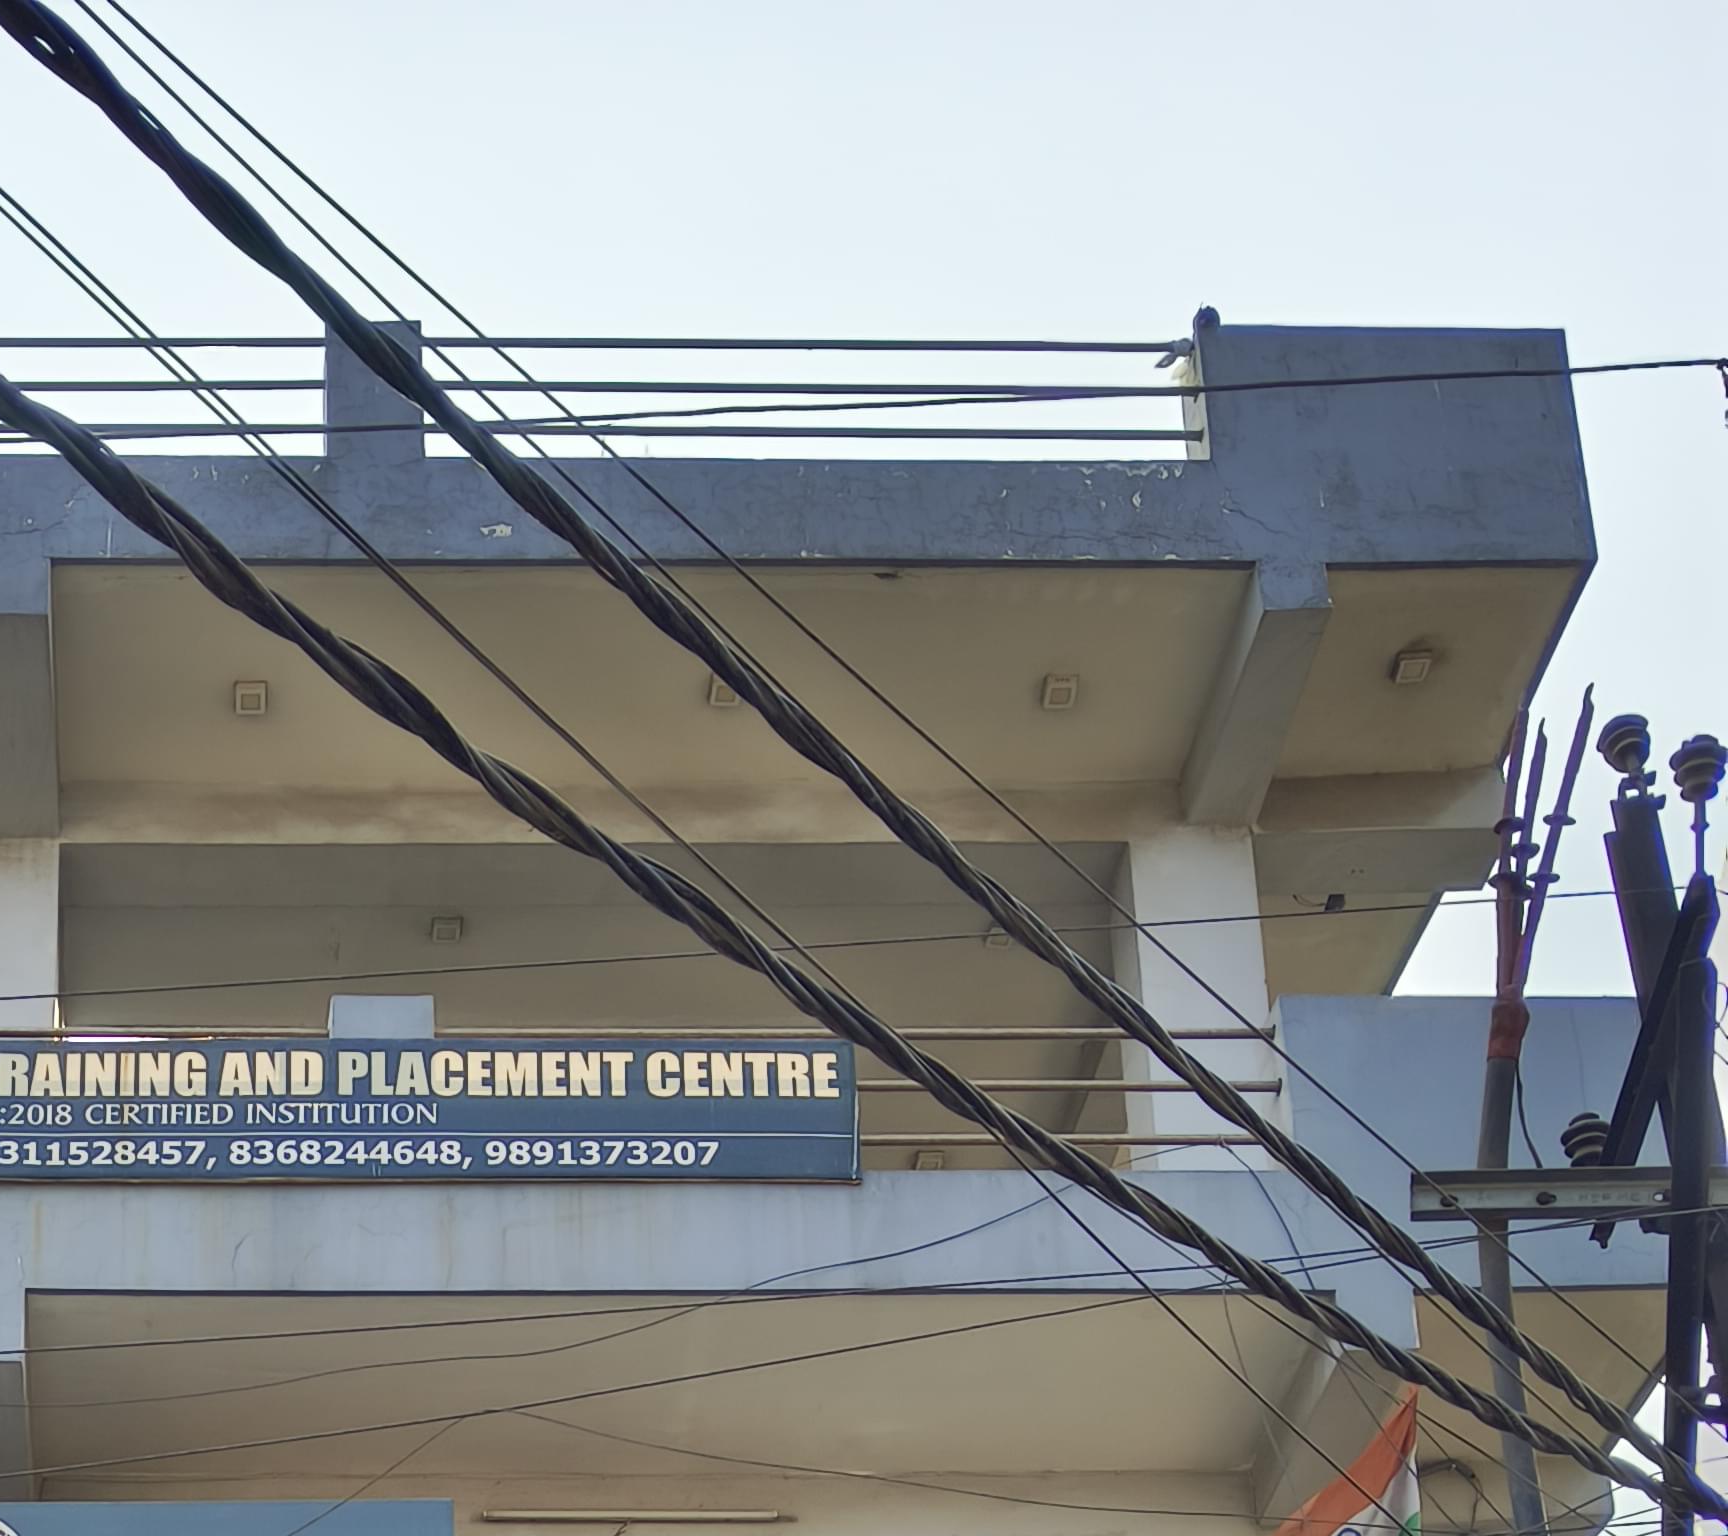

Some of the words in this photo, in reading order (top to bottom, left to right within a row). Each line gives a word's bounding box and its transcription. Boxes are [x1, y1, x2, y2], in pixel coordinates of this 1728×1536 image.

[218, 1052, 324, 1096] AND
[338, 1051, 633, 1097] PLACEMENT
[645, 1051, 840, 1098] CENTRE
[85, 1103, 234, 1125] CERTIFIED
[246, 1102, 438, 1125] INSTITUTION
[229, 1140, 472, 1169] 8368244648,
[485, 1140, 719, 1166] 9891373207
